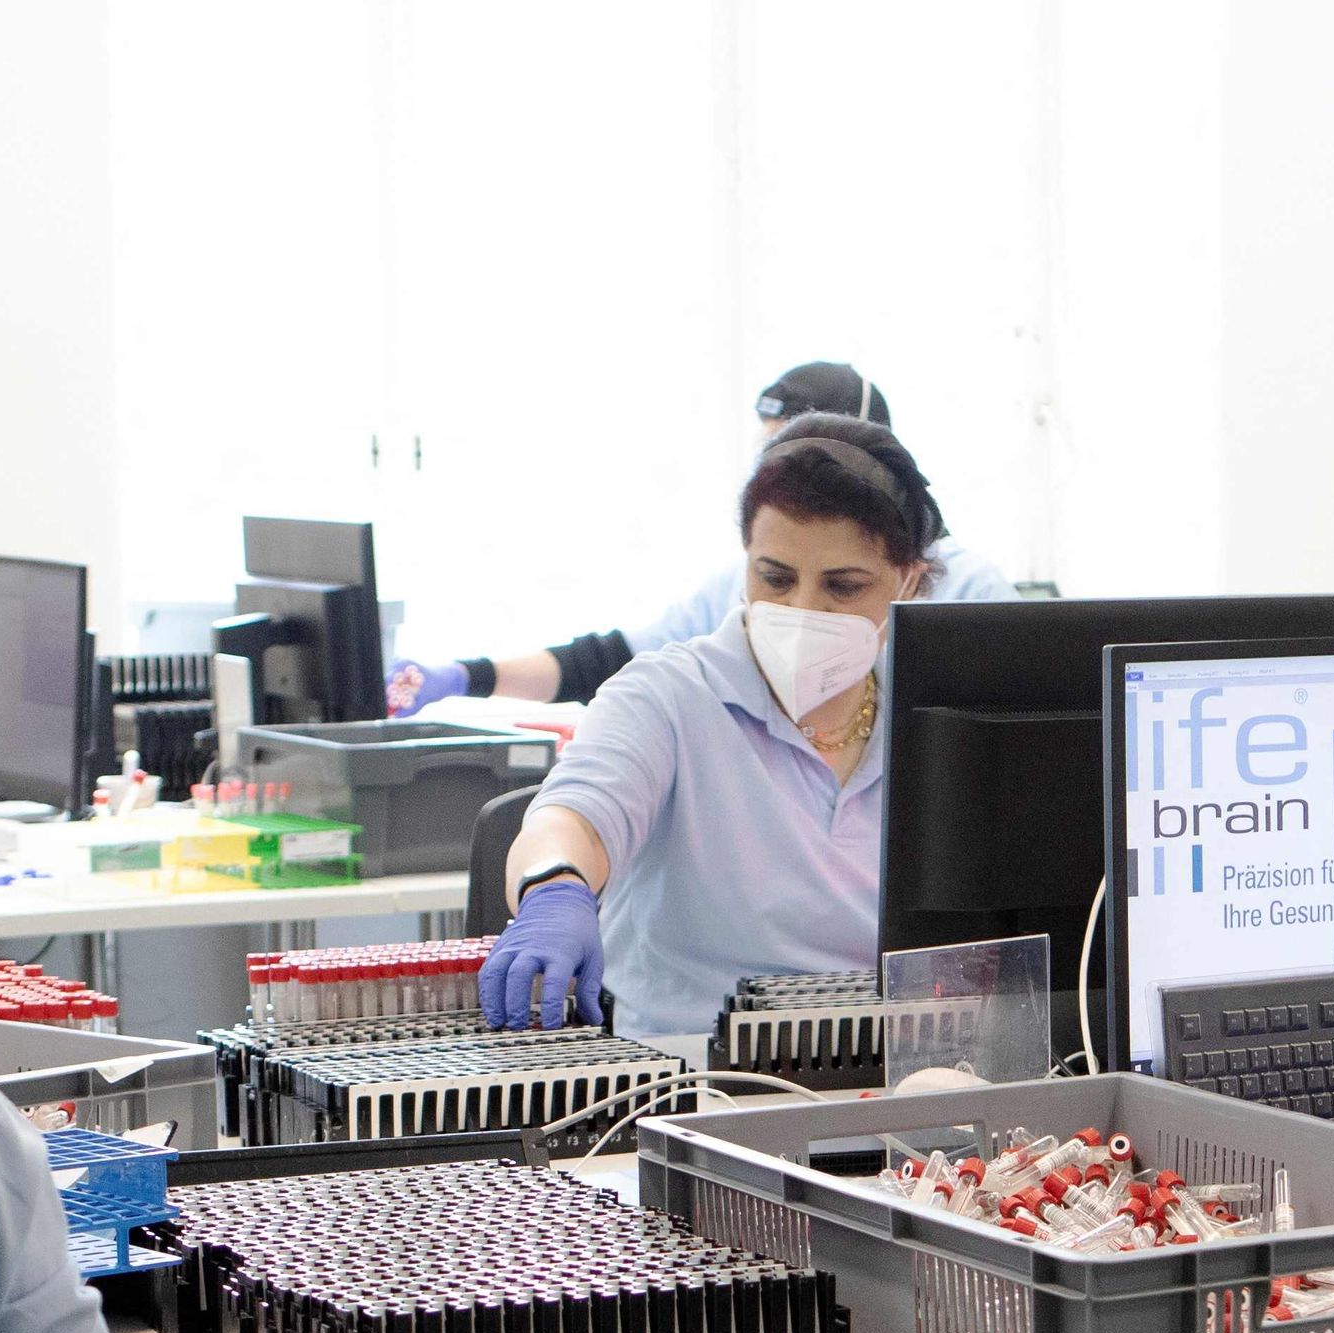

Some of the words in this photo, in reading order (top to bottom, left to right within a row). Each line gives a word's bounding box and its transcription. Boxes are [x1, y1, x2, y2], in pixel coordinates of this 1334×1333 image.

[1127, 686, 1310, 792] life
[1153, 792, 1310, 839] brain
[1223, 861, 1314, 891] Präzision
[1223, 903, 1262, 929] Ihre
[1270, 899, 1334, 926] Gesun
